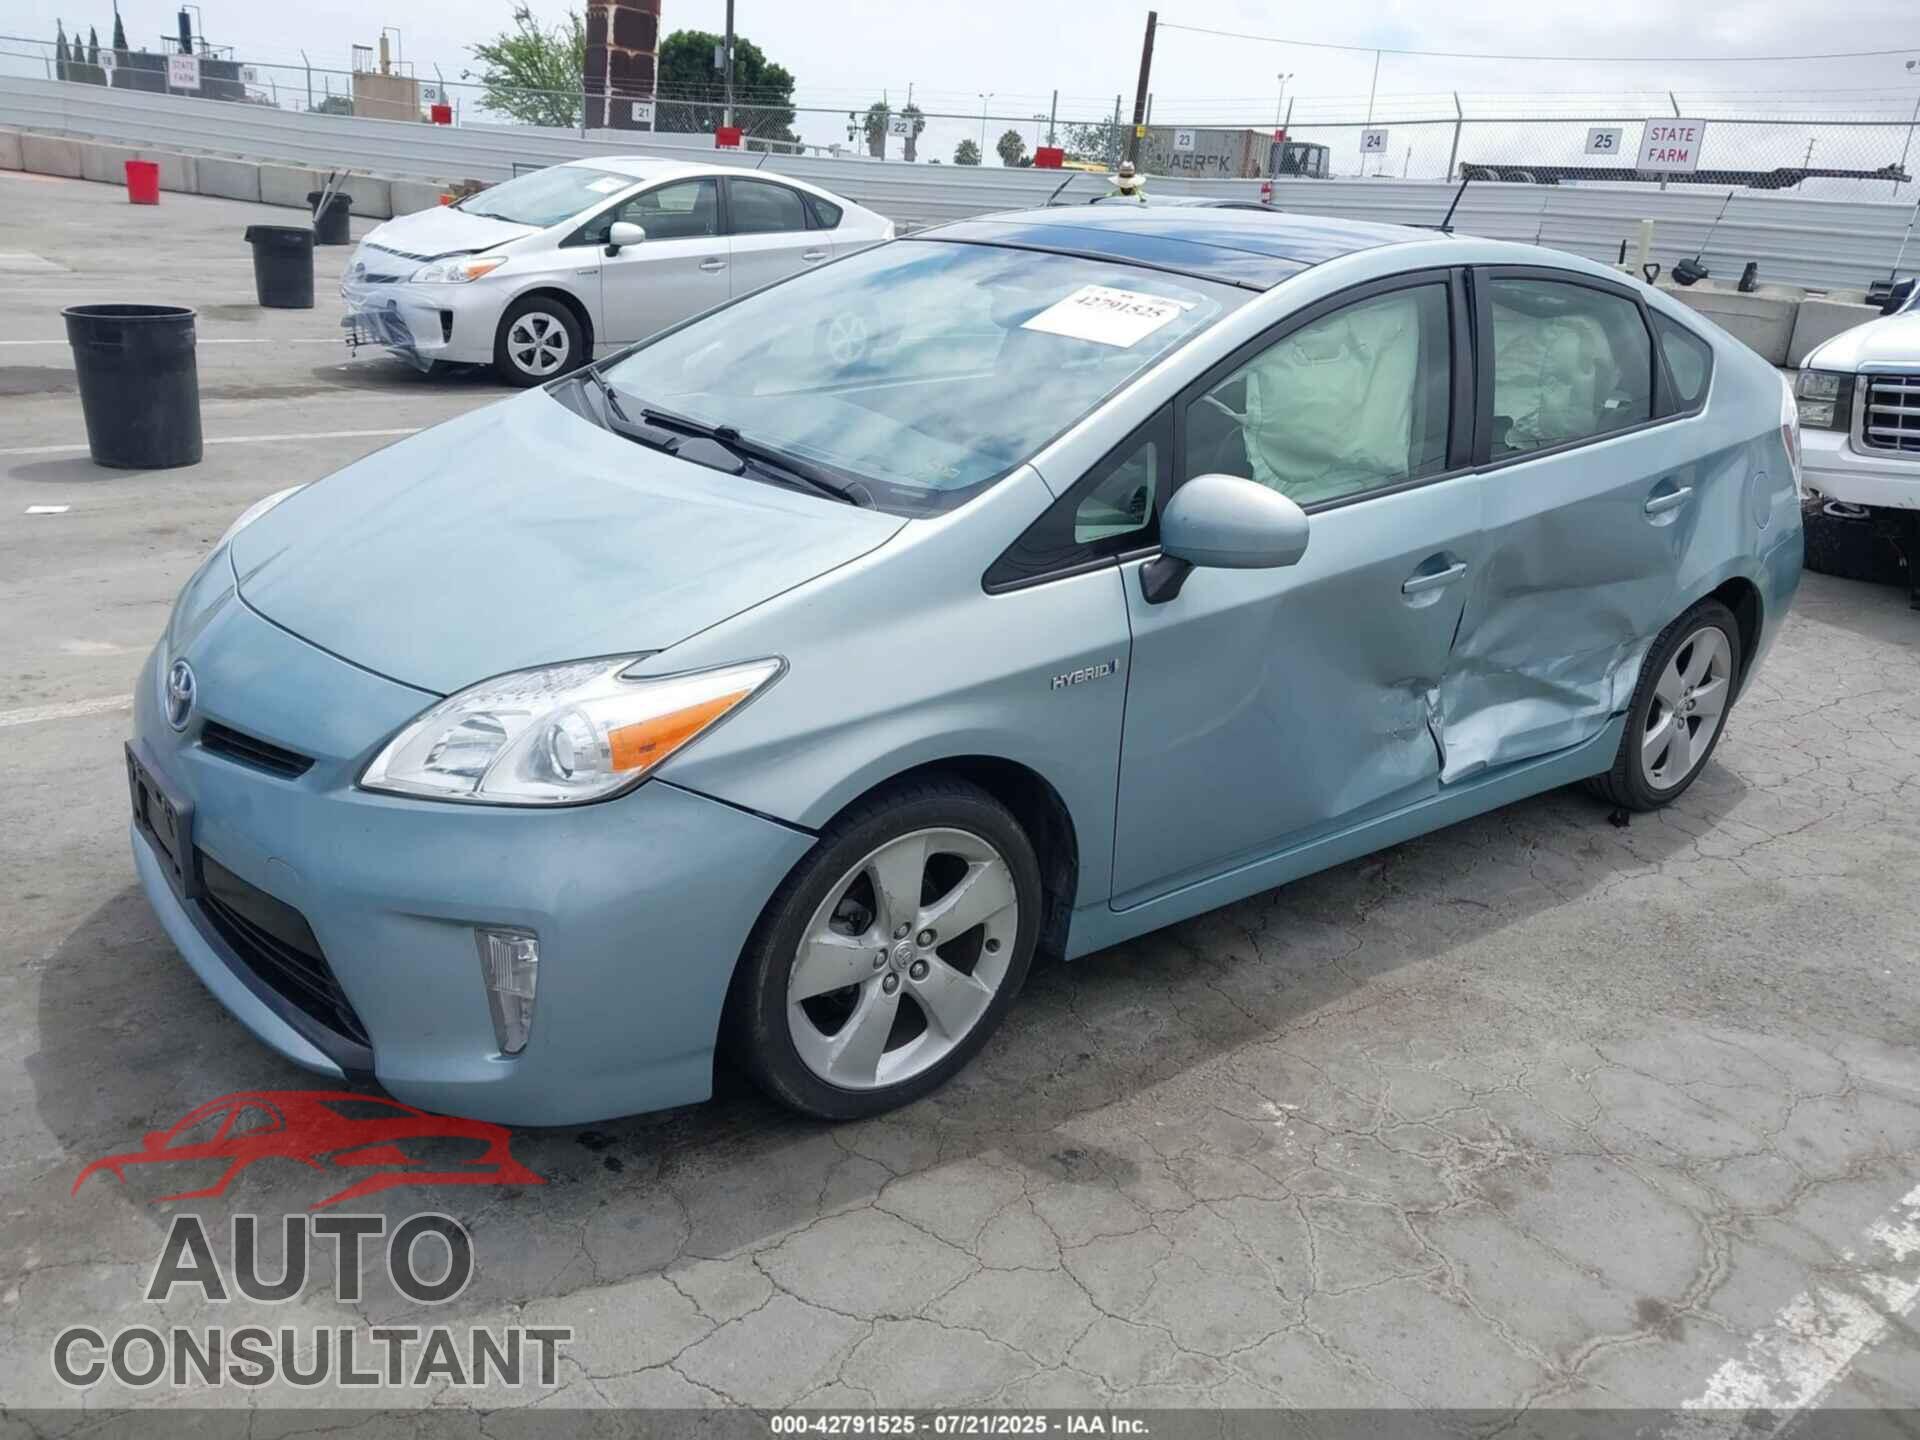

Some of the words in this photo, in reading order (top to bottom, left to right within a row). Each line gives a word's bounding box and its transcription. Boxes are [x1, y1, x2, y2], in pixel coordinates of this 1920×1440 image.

[173, 61, 194, 71] STATE
[423, 88, 436, 99] 20
[638, 107, 650, 118] 21
[894, 122, 908, 133] 22
[1178, 134, 1191, 146] 23
[1651, 127, 1696, 142] STATE
[1367, 135, 1381, 148] 24
[1594, 134, 1613, 149] 25
[1647, 148, 1689, 163] FARM
[1050, 662, 1109, 690] HYBRID
